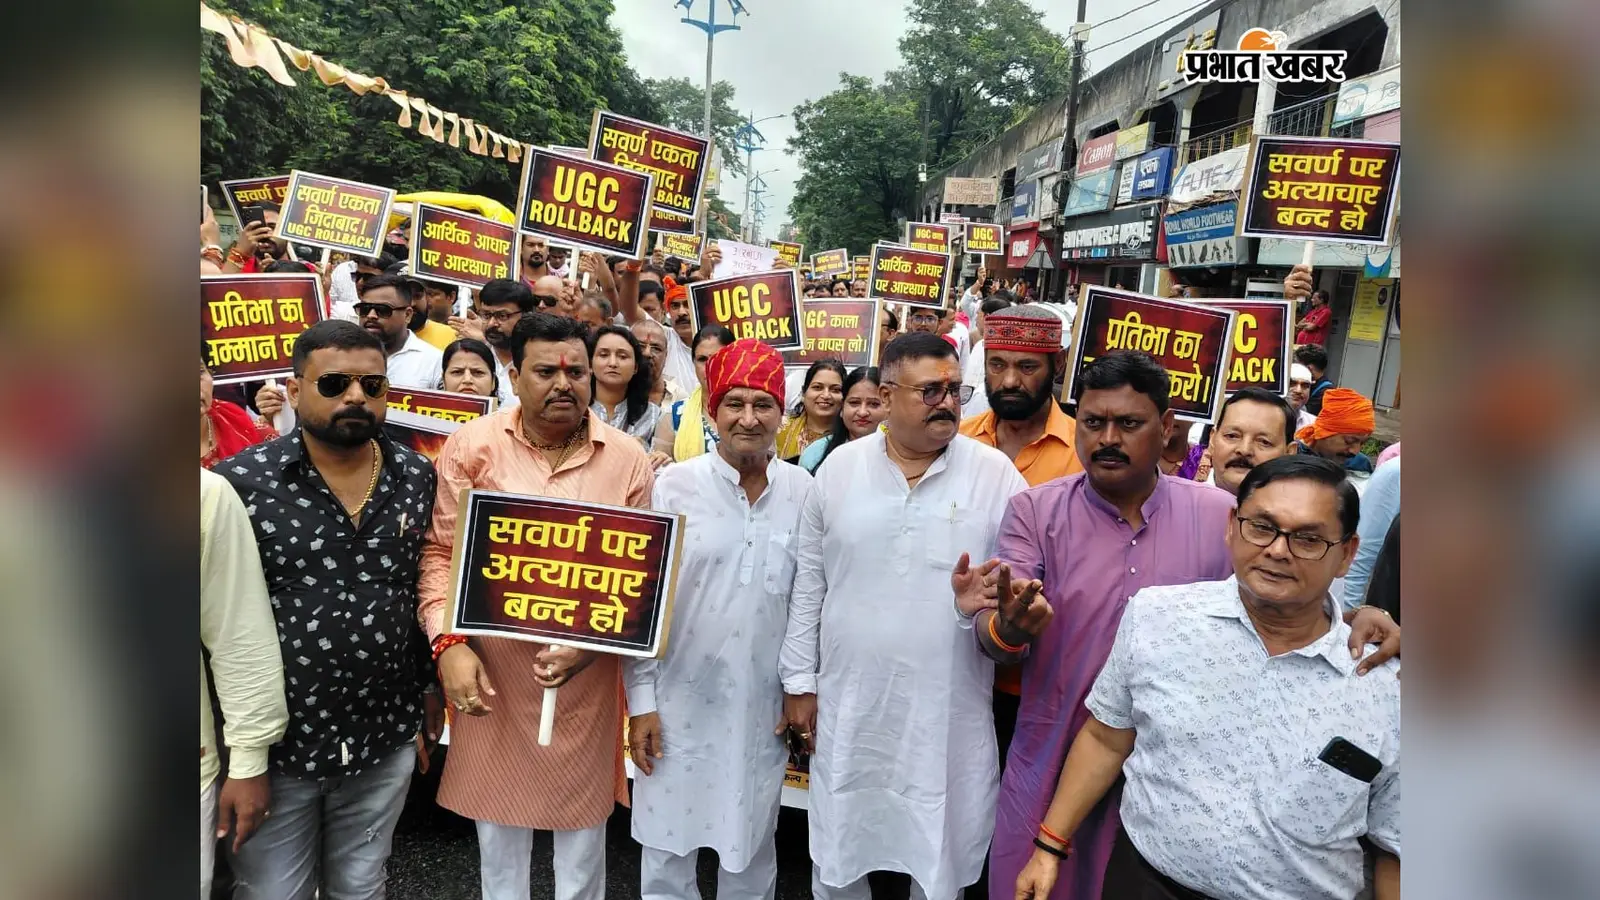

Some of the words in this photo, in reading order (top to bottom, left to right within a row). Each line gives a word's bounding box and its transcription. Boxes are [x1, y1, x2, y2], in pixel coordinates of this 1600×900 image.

[602, 127, 649, 157] सवर्ण
[650, 139, 699, 170] एकता
[1083, 143, 1115, 165] Canon
[1267, 148, 1345, 176] सवर्ण
[1349, 155, 1387, 179] पर
[553, 165, 620, 215] UGC
[1179, 164, 1224, 194] FLITE
[1262, 179, 1382, 206] अत्याचार
[234, 184, 273, 203] सवर्ण
[274, 186, 288, 199] प
[296, 183, 335, 207] सवर्ण
[339, 194, 381, 216] एकता
[529, 199, 633, 244] ROLLBACK
[1182, 215, 1201, 230] WORLD
[1201, 209, 1234, 228] FOOTWEAR
[1276, 206, 1333, 229] बन्द
[1340, 203, 1368, 231] हो
[287, 222, 312, 238] UGC
[315, 229, 373, 249] ROLLBACK
[422, 220, 472, 245] आर्थिक
[915, 228, 932, 239] UGC
[968, 240, 999, 250] ROLLBACK
[973, 227, 993, 240] UGC
[421, 249, 441, 267] पर
[444, 254, 493, 278] आरक्षण
[877, 256, 913, 273] आर्थिक
[713, 282, 772, 322] UGC
[875, 279, 889, 292] पर
[890, 281, 927, 297] आरक्षण
[929, 282, 940, 299] हो
[208, 290, 275, 332] प्रतिभा
[277, 298, 305, 323] का
[830, 314, 860, 329] काला
[818, 338, 845, 352] वापस
[1105, 311, 1170, 356] प्रतिभा
[1173, 329, 1203, 361] का
[488, 515, 594, 553] सवर्ण
[600, 527, 652, 561] पर
[481, 551, 648, 599] अत्याचार
[503, 590, 579, 627] बन्द
[589, 594, 629, 634] हो
